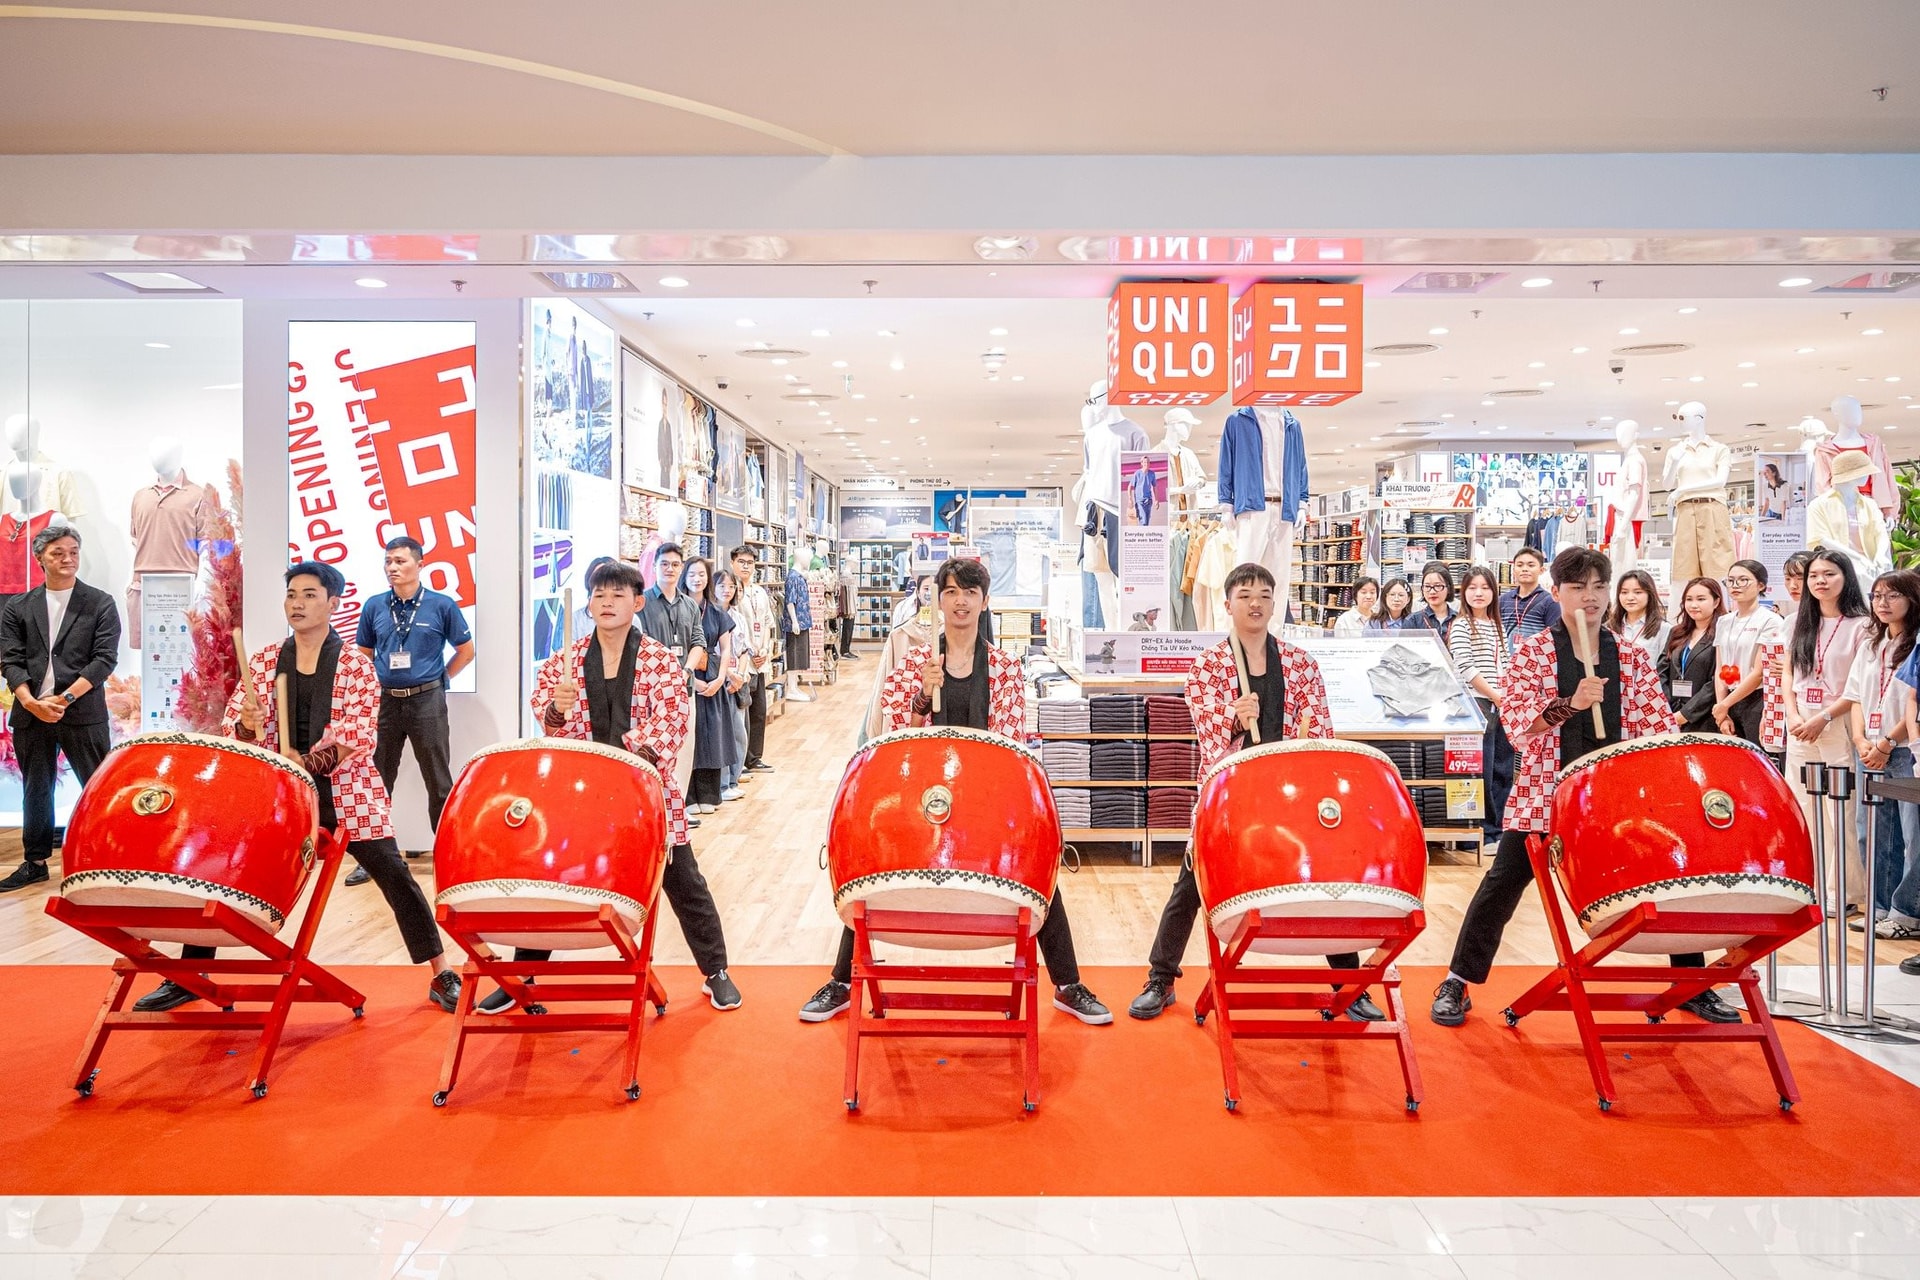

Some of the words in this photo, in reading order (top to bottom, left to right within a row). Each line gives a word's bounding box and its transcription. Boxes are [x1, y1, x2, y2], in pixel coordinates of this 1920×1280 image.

[1132, 296, 1207, 333] UNI
[1269, 297, 1347, 333] ユニ
[1132, 341, 1215, 384] QLO
[1266, 343, 1347, 378] クロ
[288, 401, 348, 565] OPENING
[1424, 472, 1442, 482] UT
[1598, 472, 1616, 486] UT
